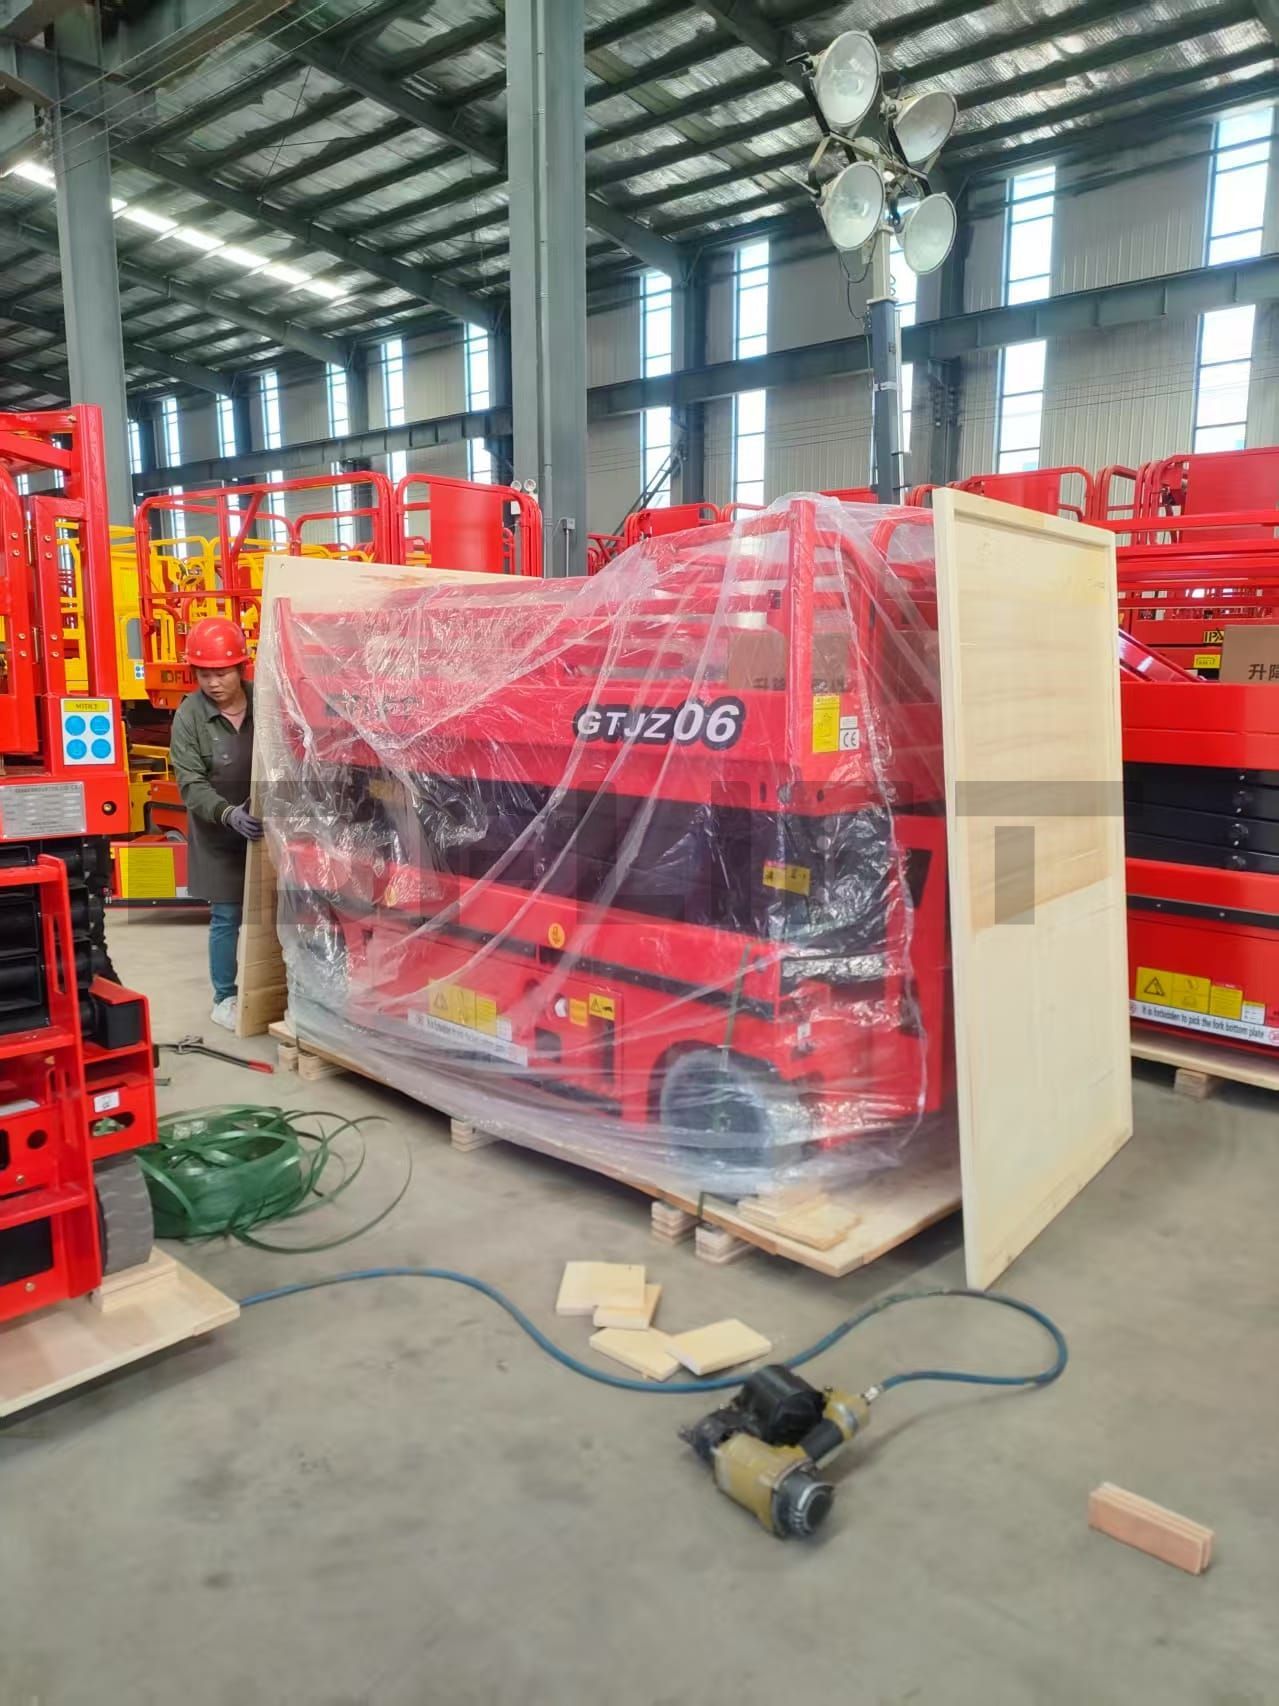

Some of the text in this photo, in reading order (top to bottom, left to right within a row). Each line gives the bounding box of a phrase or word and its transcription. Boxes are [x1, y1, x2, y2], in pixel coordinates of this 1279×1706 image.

[577, 703, 740, 743] GTJZ06
[1153, 1008, 1180, 1020] forbidden
[1201, 1016, 1211, 1027] the
[1212, 1019, 1224, 1030] fork
[1225, 1021, 1248, 1035] bottom
